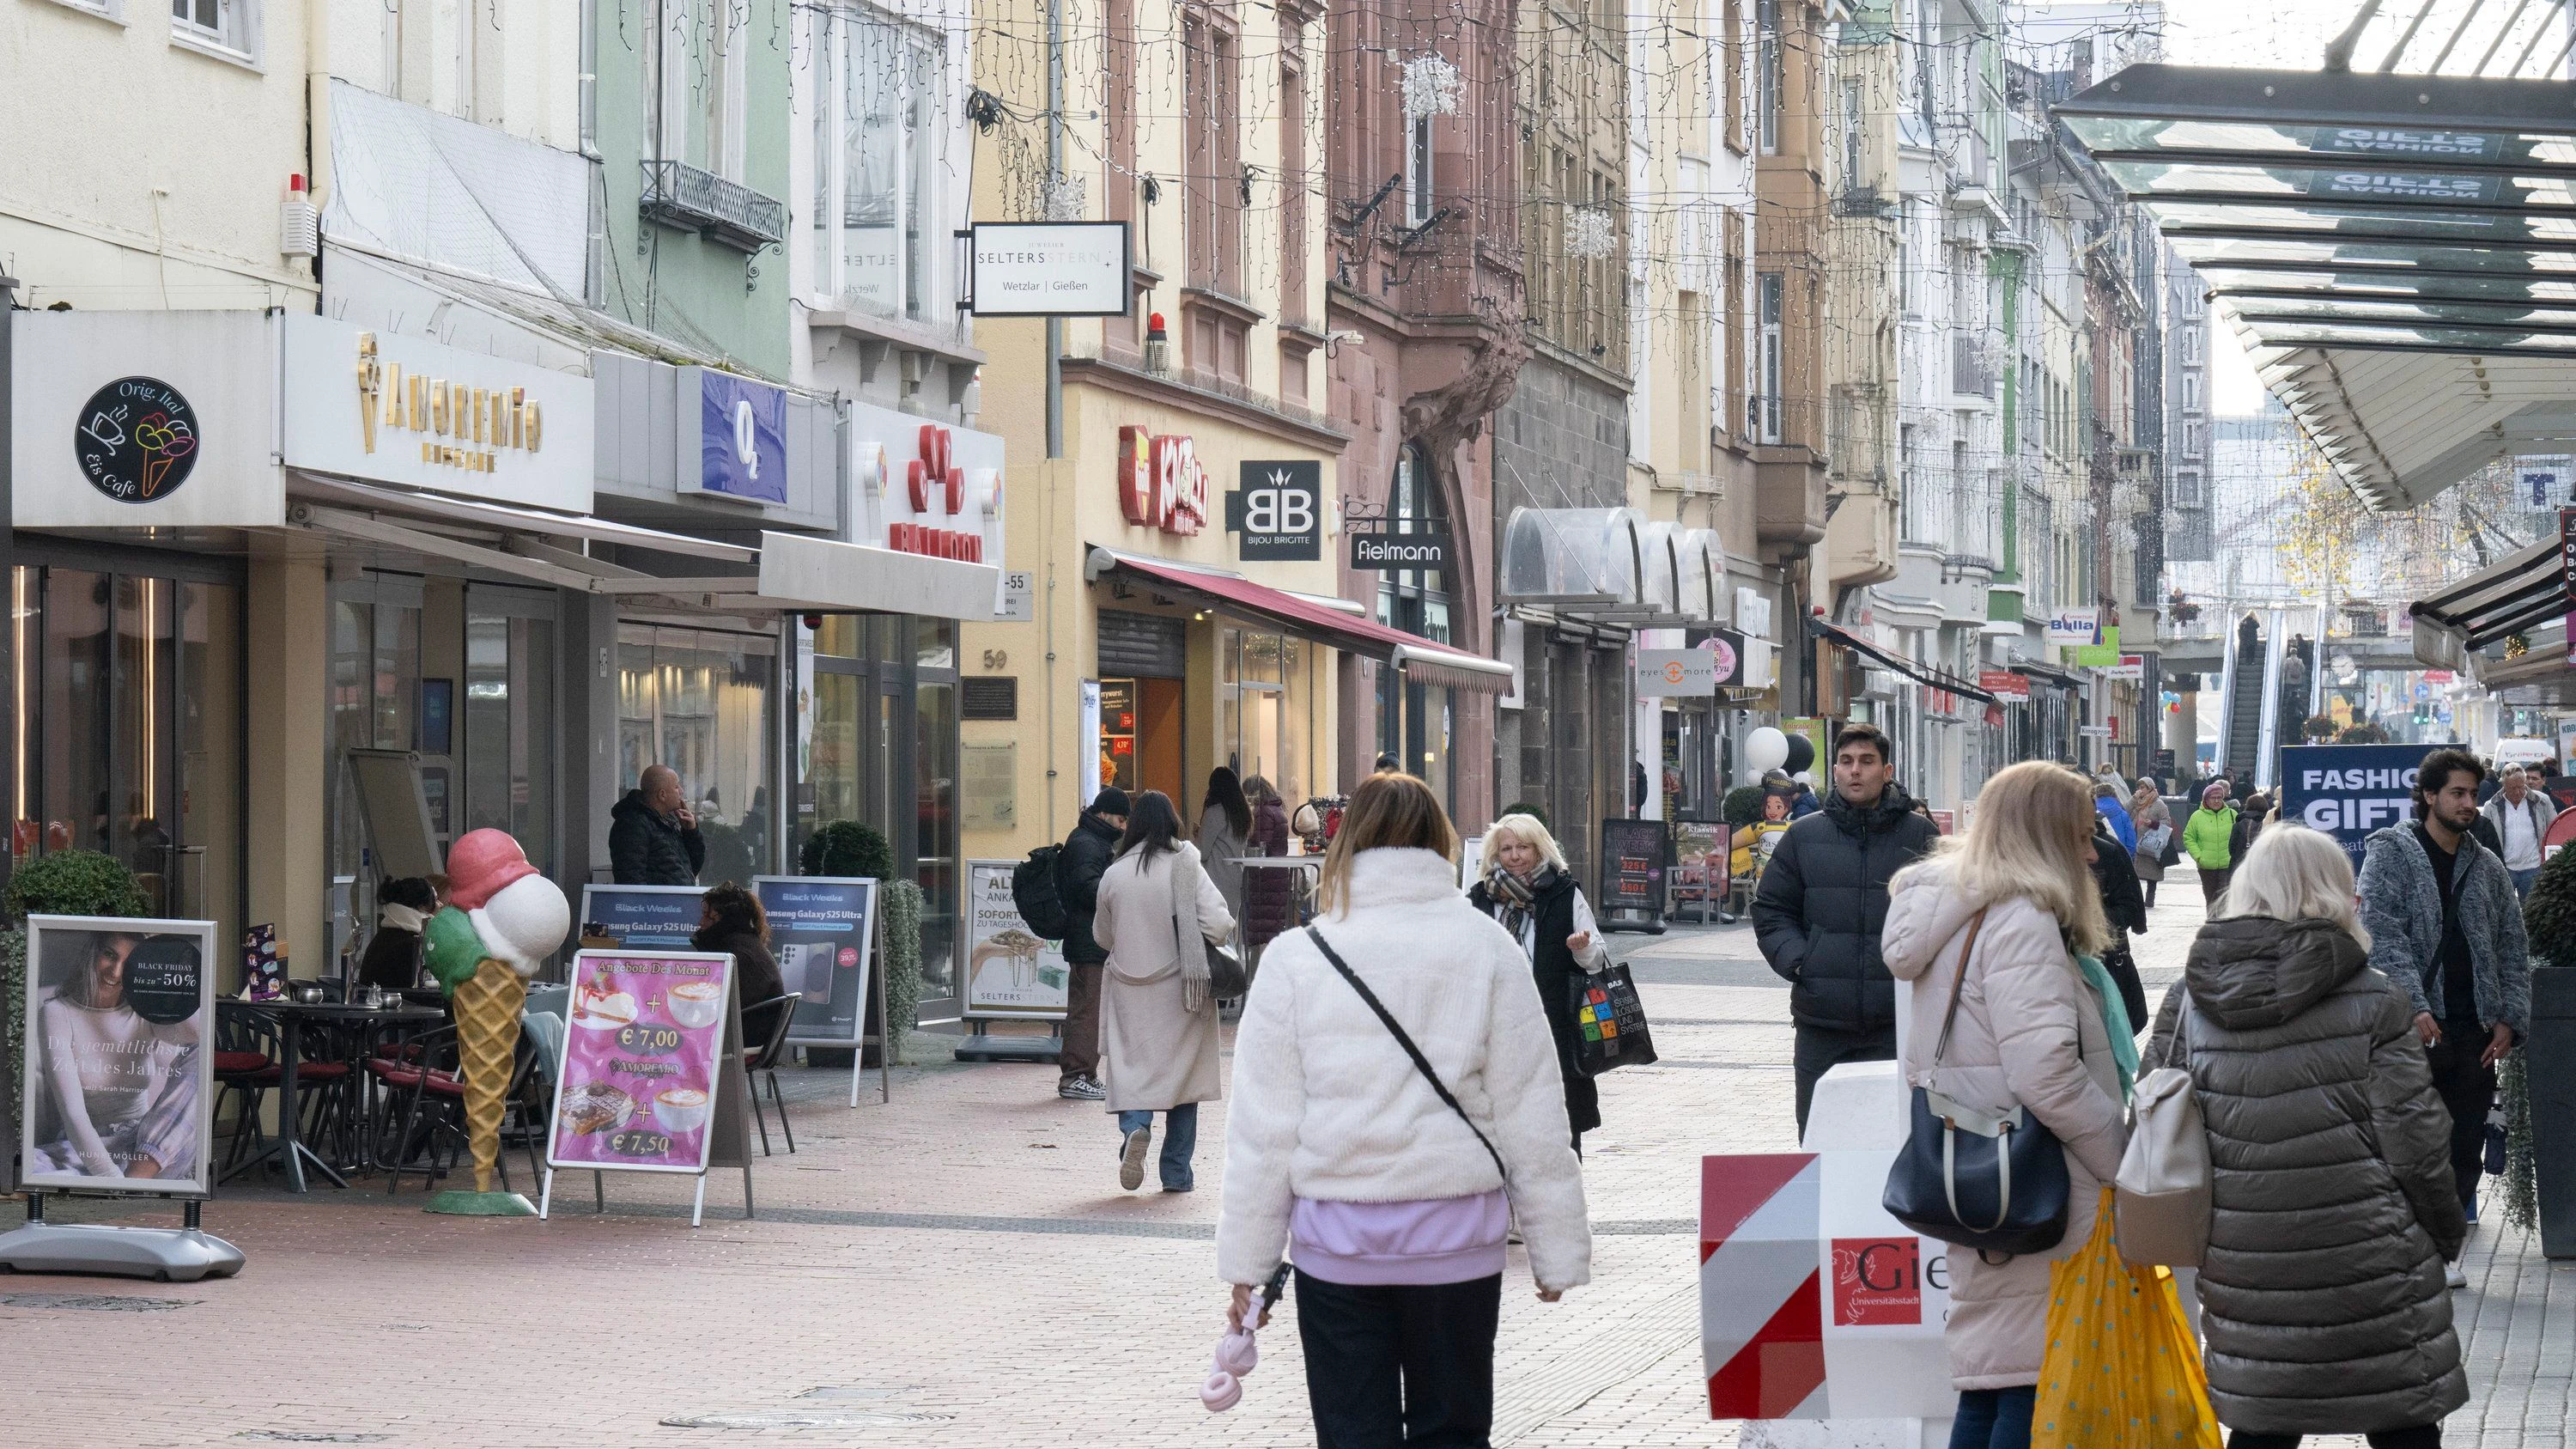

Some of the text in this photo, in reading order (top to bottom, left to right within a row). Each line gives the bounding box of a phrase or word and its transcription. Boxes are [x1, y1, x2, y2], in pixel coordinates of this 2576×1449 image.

[1003, 280, 1088, 291] Wetzlar Gießen
[119, 382, 155, 401] Orig.
[86, 453, 136, 497] Eis Cafe
[1248, 536, 1309, 545] BIJOU BRIGITTE
[2051, 619, 2093, 632] Bulla
[983, 649, 1007, 669] 59
[1614, 828, 1656, 840] BLACK
[1688, 825, 1718, 834] Klassik
[1615, 840, 1656, 853] WEEK
[782, 893, 810, 902] Black
[616, 904, 682, 913] Black Weeks
[798, 910, 826, 920] Galaxy
[826, 910, 841, 919] S25
[841, 910, 862, 919] Ultra
[978, 910, 1019, 920] SOFORT
[632, 922, 663, 933] Galaxy
[664, 922, 679, 931] S25
[138, 962, 163, 971] BLACK
[598, 960, 710, 976] Angebote Des Monat
[157, 973, 197, 987] -50%
[622, 1029, 677, 1049] € 7,00
[82, 1039, 190, 1056] gemütlichste
[93, 1059, 121, 1075] des
[126, 1061, 182, 1078] Jahres
[612, 1135, 669, 1154] € 7,50
[1851, 1296, 1919, 1306] Universitätsstadt
